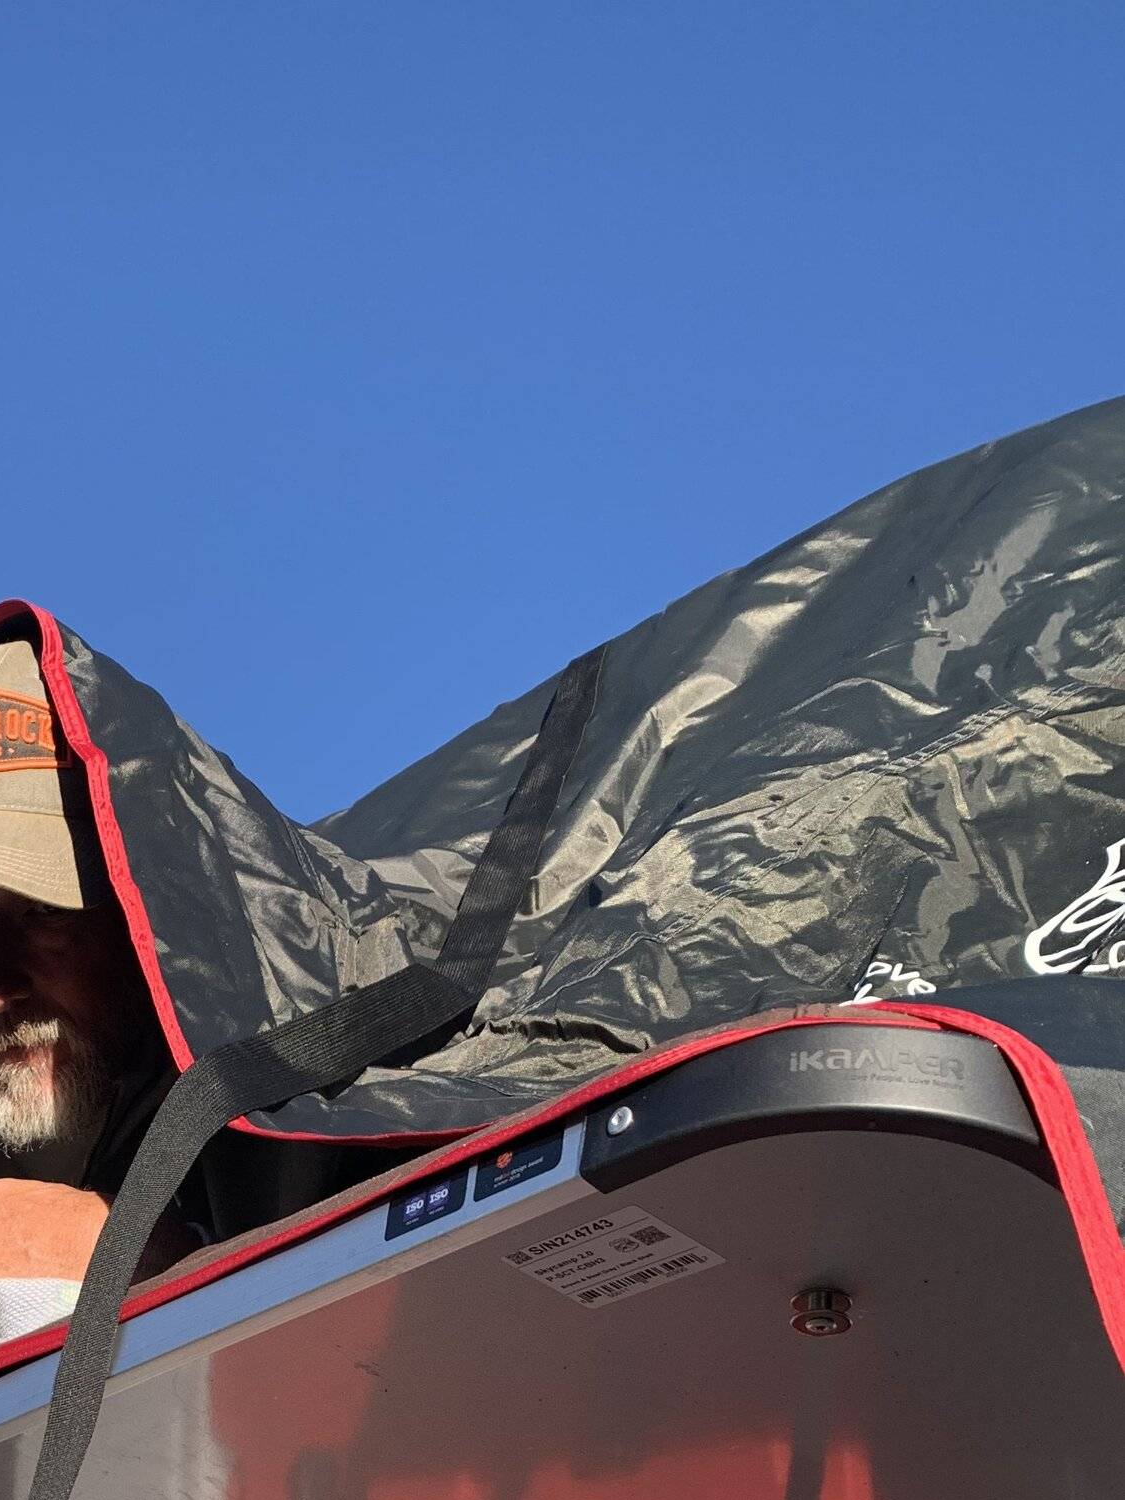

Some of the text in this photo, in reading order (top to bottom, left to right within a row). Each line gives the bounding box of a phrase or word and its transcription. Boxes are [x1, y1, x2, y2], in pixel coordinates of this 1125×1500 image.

[429, 1188, 449, 1204] ISO
[405, 1199, 424, 1215] ISO
[528, 1219, 614, 1256] S/N214743
